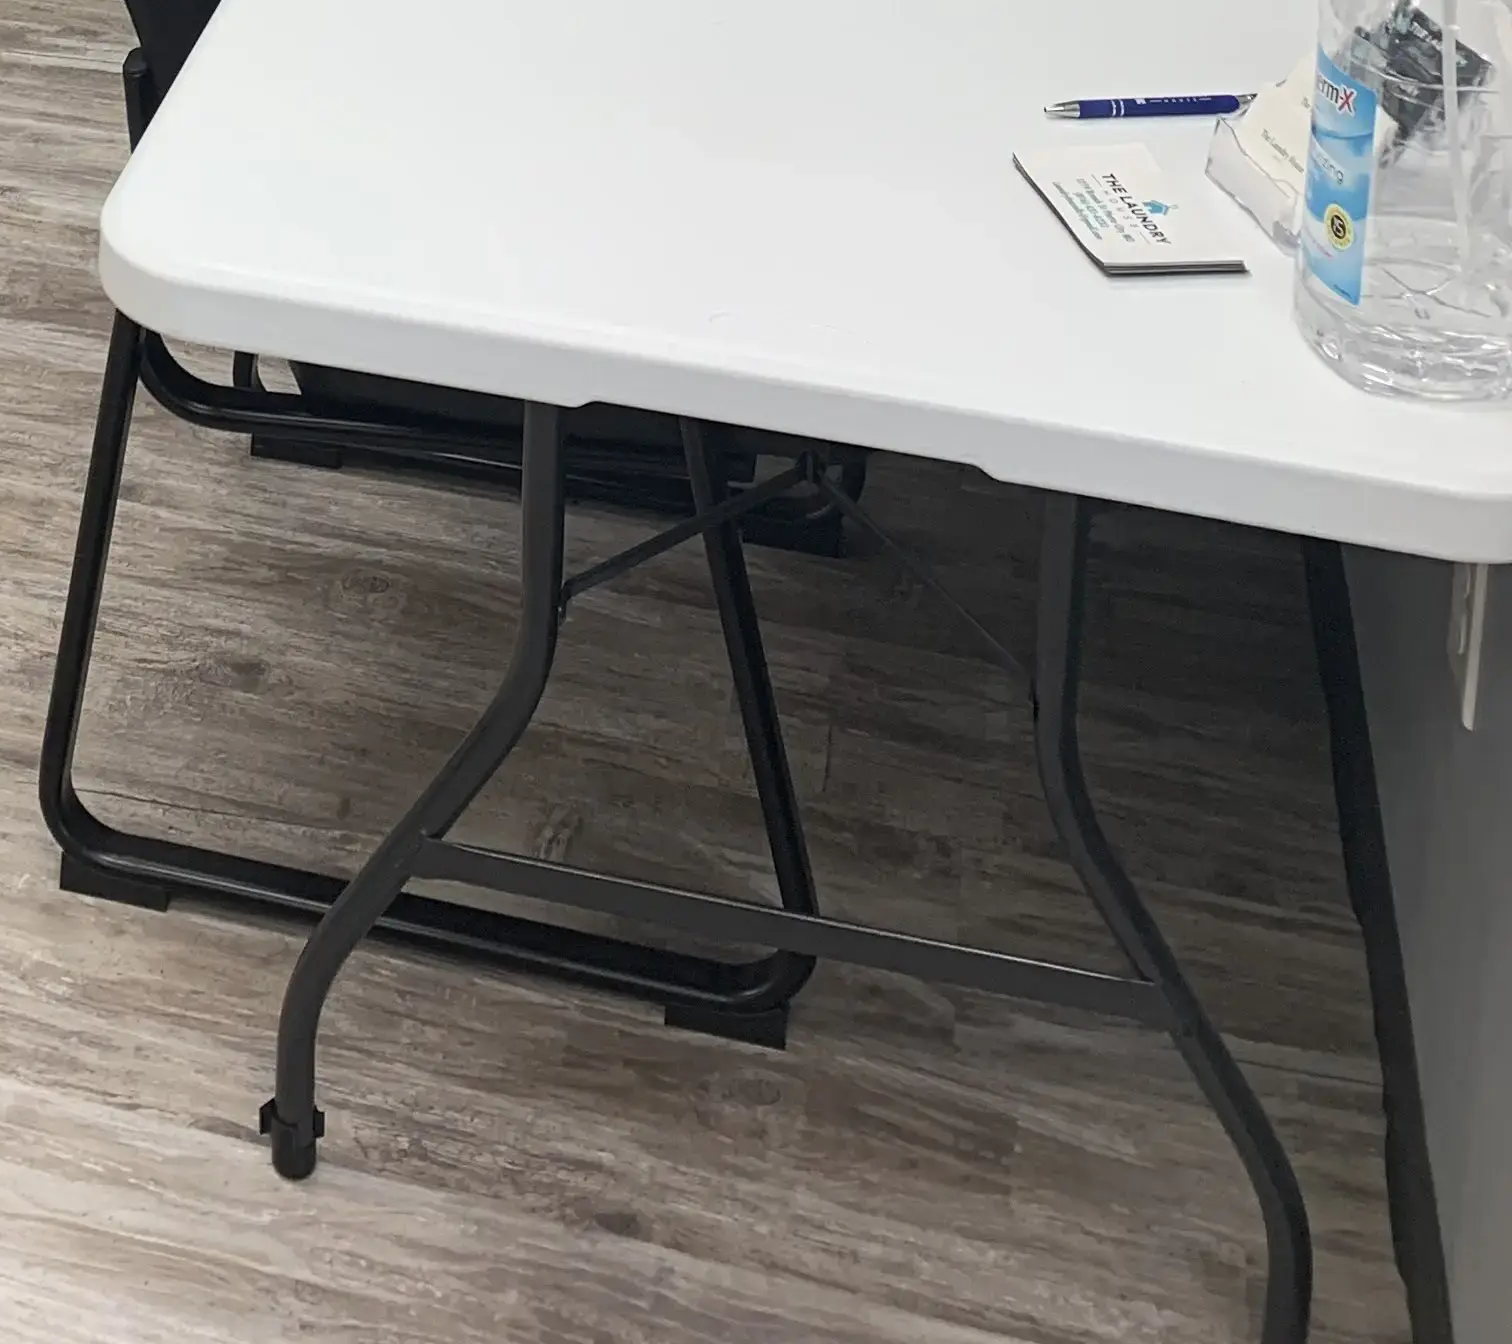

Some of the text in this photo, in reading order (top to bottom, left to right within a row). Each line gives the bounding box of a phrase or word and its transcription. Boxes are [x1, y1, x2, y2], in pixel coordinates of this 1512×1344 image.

[1316, 73, 1356, 117] erm-X
[1102, 173, 1172, 245] THE LAUNDRY
